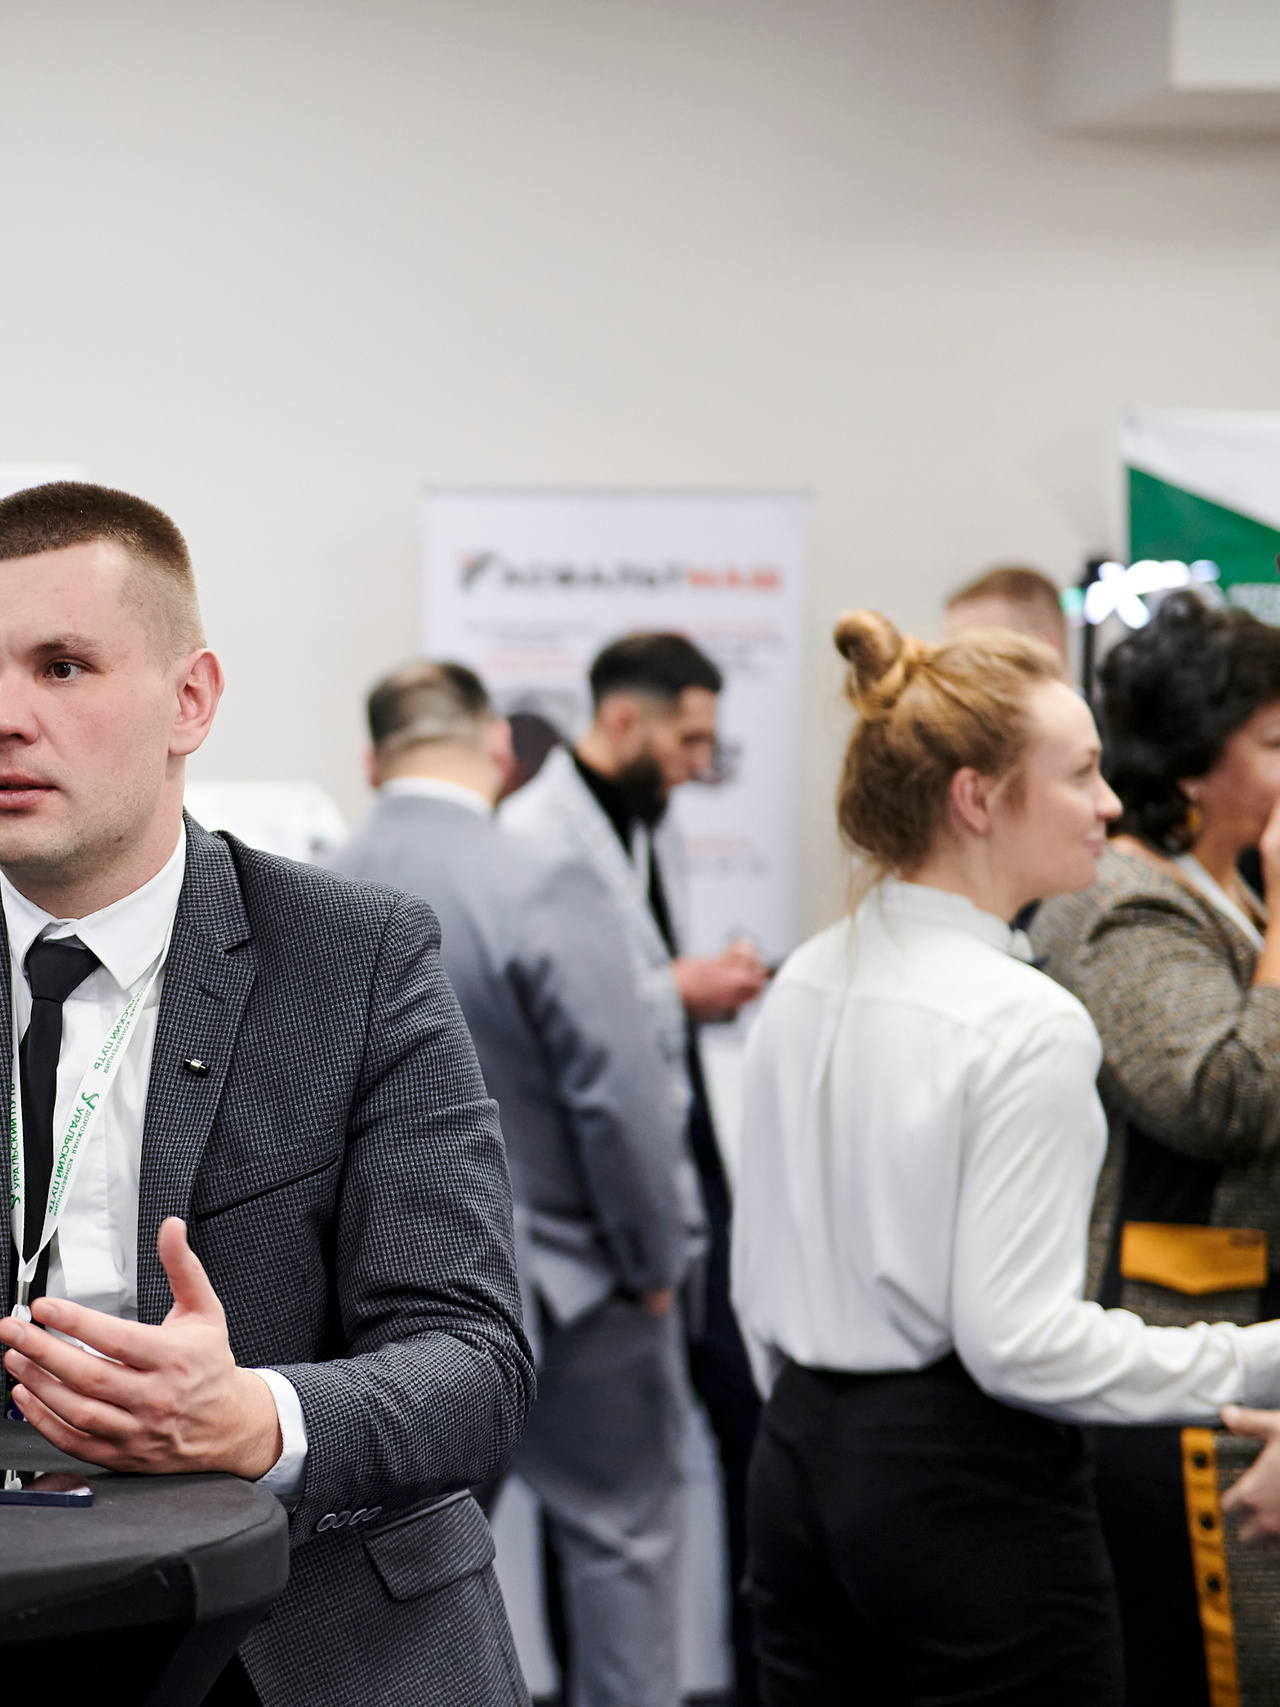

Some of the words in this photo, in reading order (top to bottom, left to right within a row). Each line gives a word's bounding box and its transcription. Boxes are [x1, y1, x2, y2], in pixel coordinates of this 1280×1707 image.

[94, 1041, 114, 1069] ПУТЬ
[55, 1106, 85, 1179] УРАЛЬСКИЙ
[72, 1109, 92, 1155] ДОРОЖНАЯ
[48, 1181, 61, 1214] ПУТЬ
